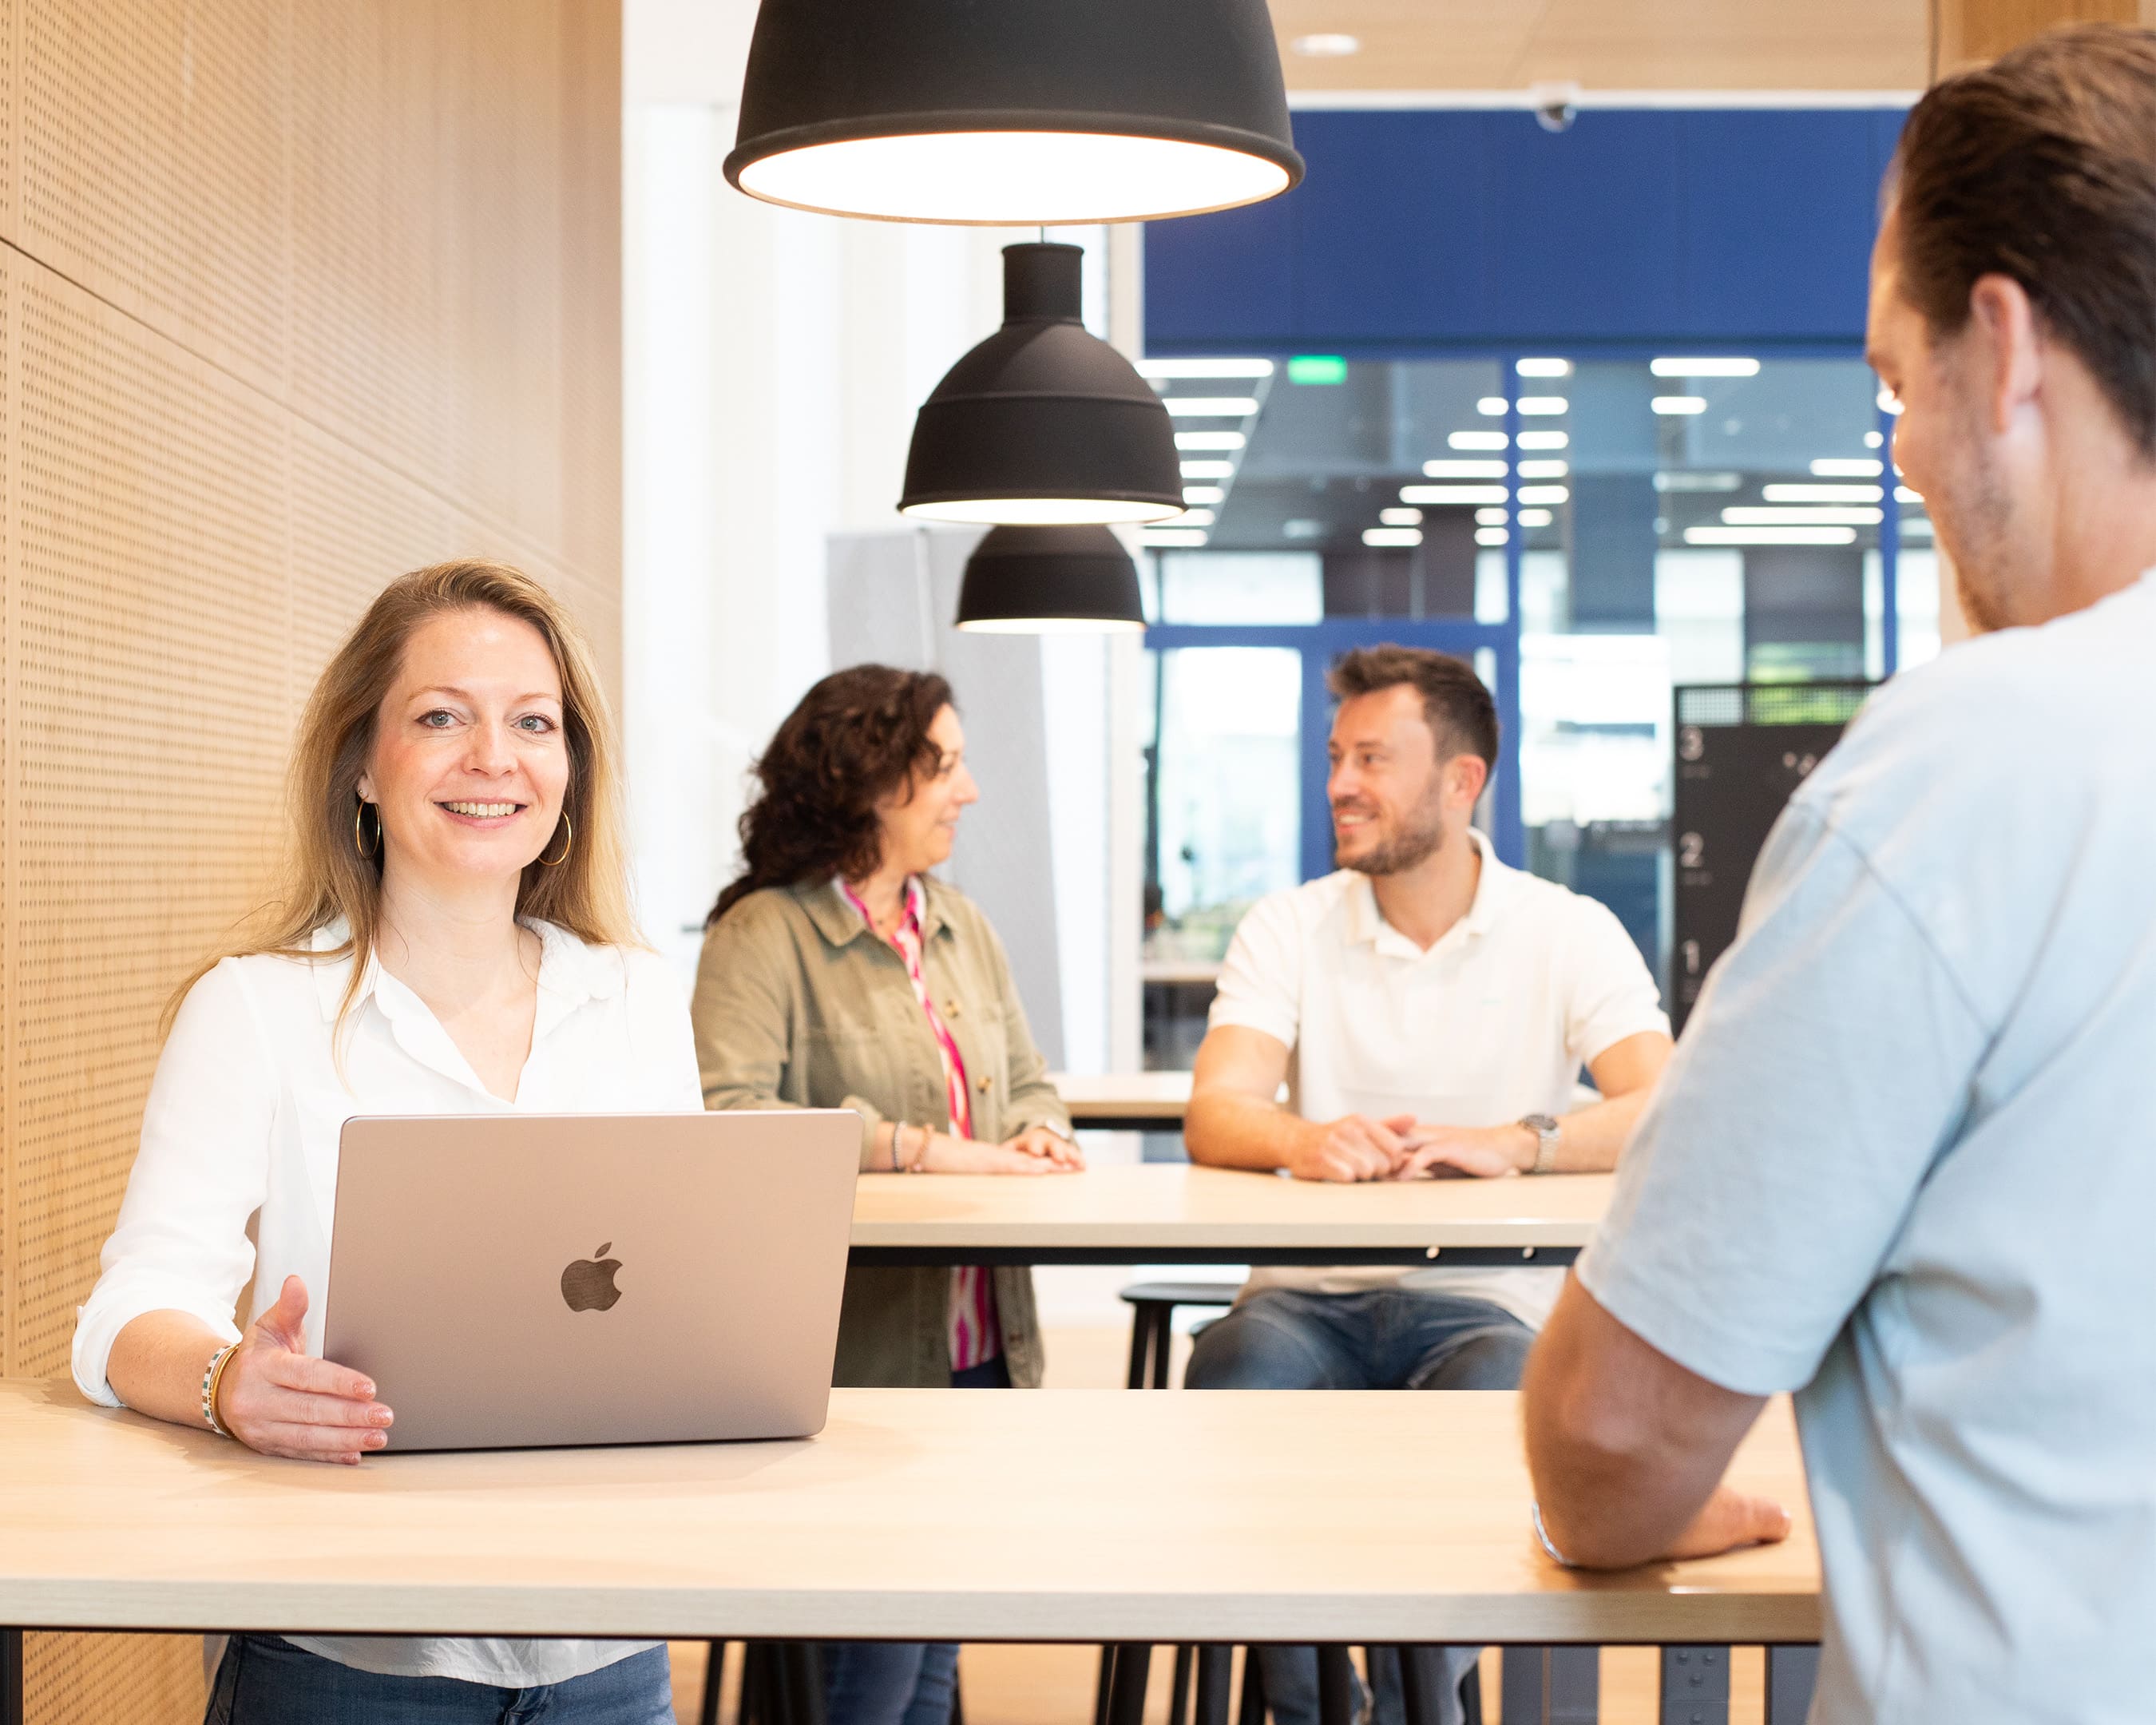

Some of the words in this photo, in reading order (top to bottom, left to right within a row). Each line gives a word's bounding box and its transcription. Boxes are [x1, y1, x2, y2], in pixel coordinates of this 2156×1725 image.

[1680, 726, 1703, 760] 3
[1680, 832, 1703, 867] 2
[1682, 939, 1699, 974] 1
